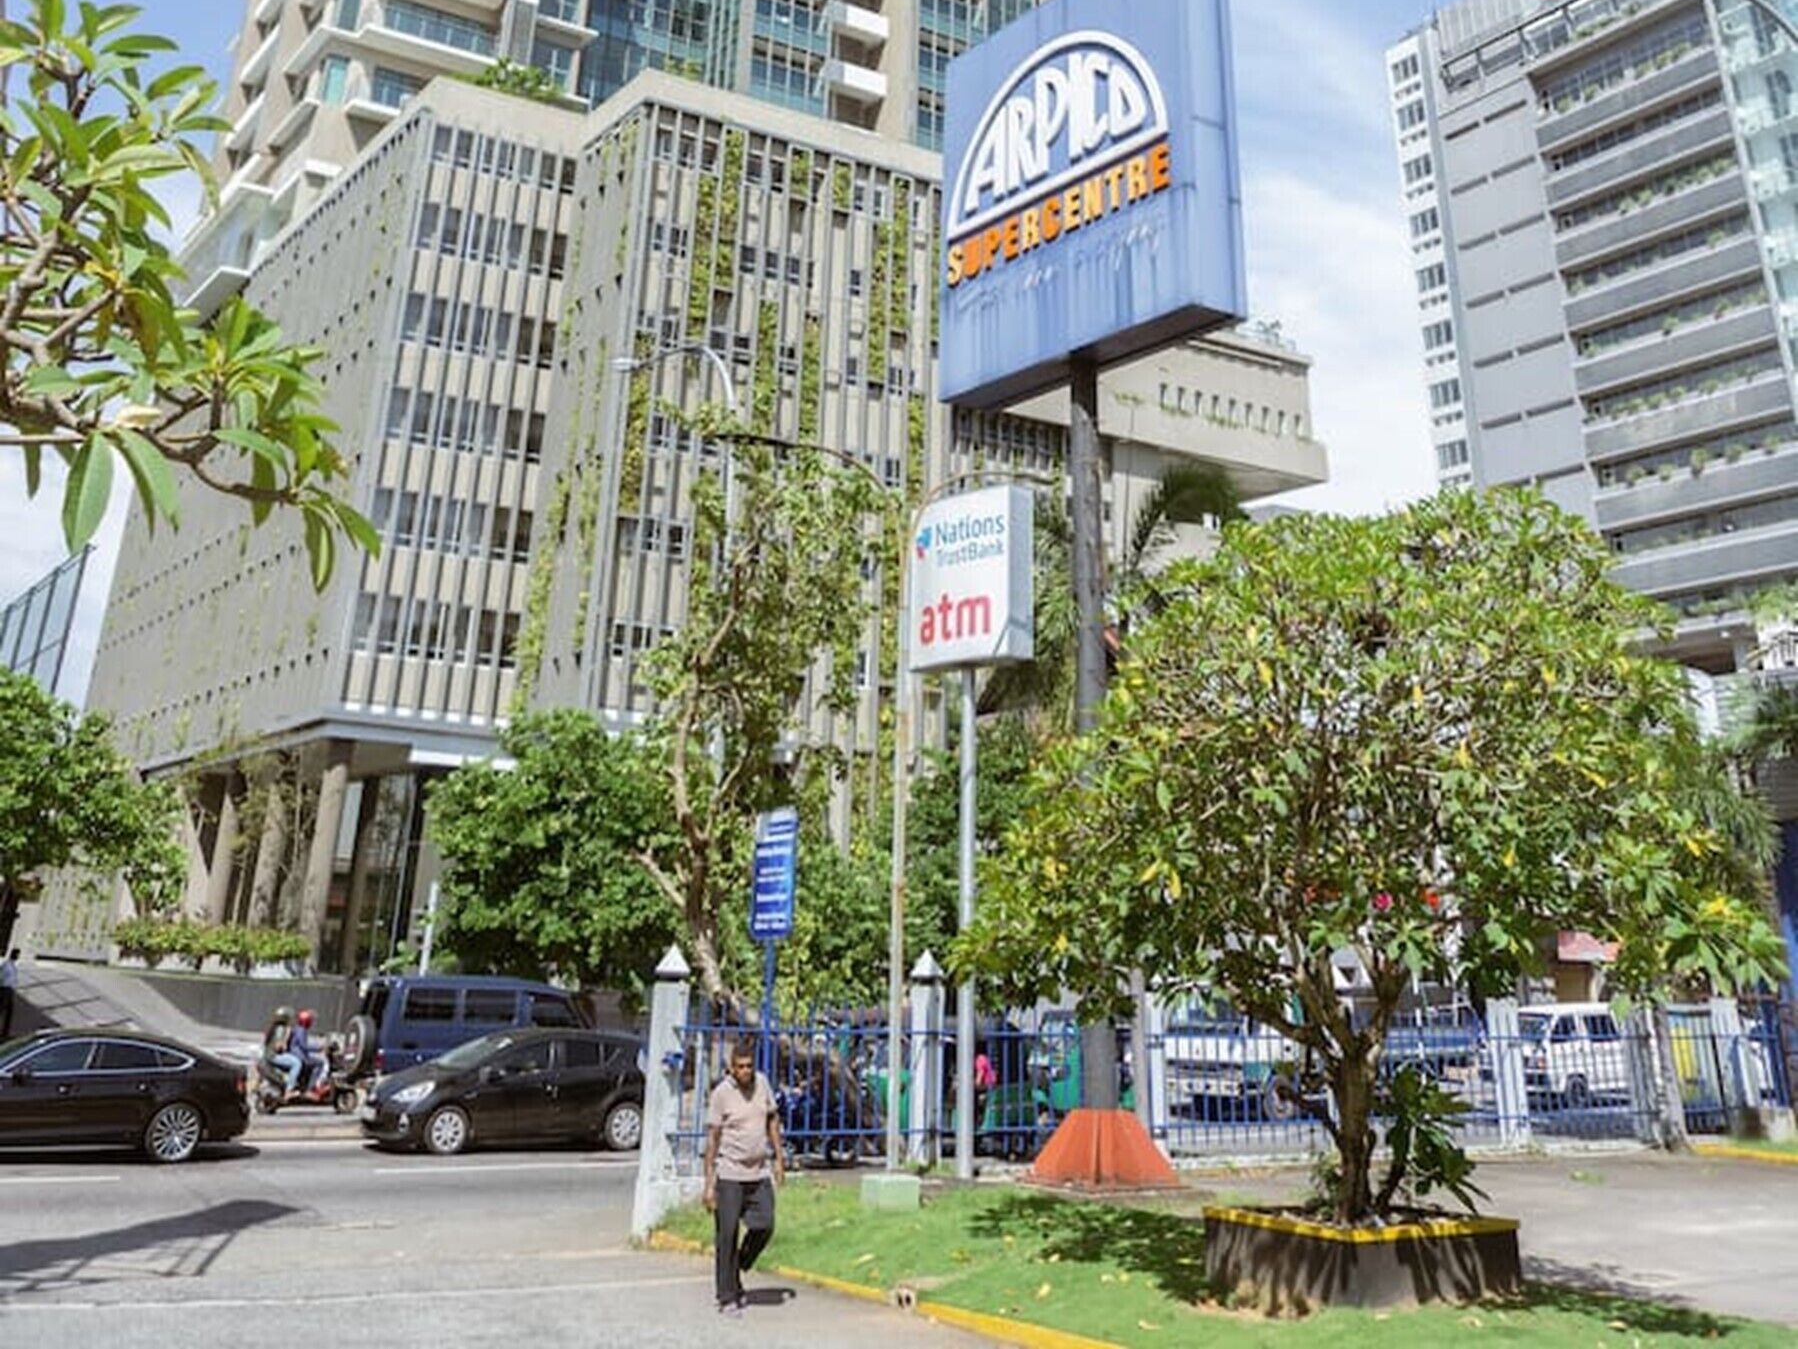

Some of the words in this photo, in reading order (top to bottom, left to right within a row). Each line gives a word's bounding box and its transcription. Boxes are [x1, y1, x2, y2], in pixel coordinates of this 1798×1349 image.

[963, 51, 1149, 214] ARPICO
[947, 144, 1172, 286] SUPERCENTRE
[935, 513, 1005, 547] Nations
[919, 591, 992, 646] atm
